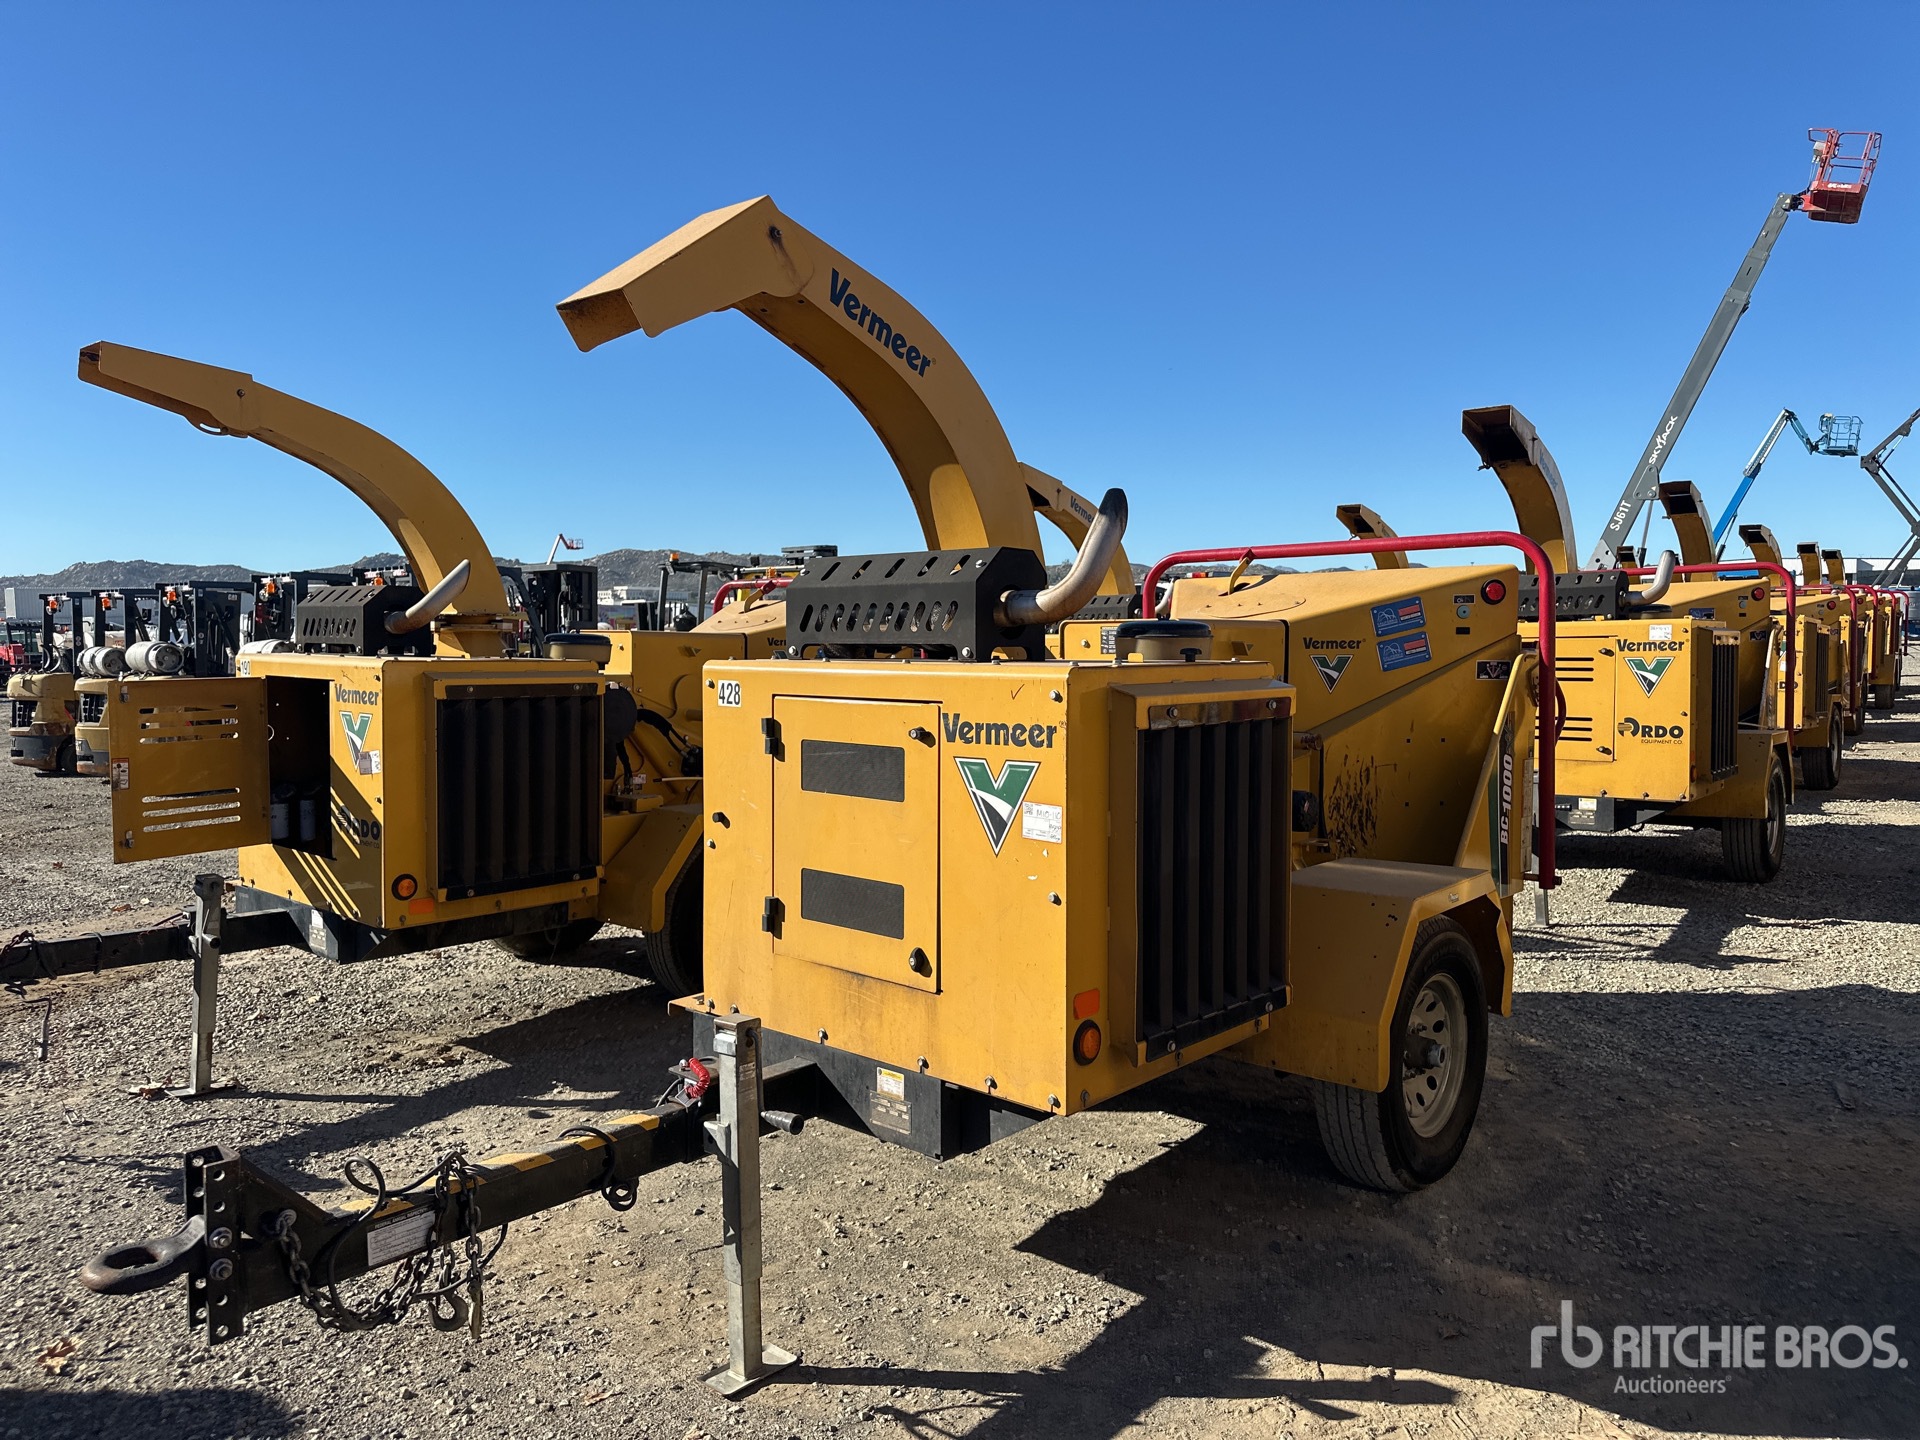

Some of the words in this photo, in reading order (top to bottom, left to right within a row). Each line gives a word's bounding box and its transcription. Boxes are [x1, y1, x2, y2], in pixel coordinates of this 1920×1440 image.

[829, 267, 931, 378] Vermeer
[1648, 415, 1679, 464] SKYJACK
[1610, 500, 1631, 531] SJ61T
[1303, 637, 1362, 650] Vermeer
[1617, 639, 1685, 652] Vermeer
[335, 683, 379, 705] Vermeer
[719, 683, 740, 705] 428
[942, 713, 1057, 748] Vermeer
